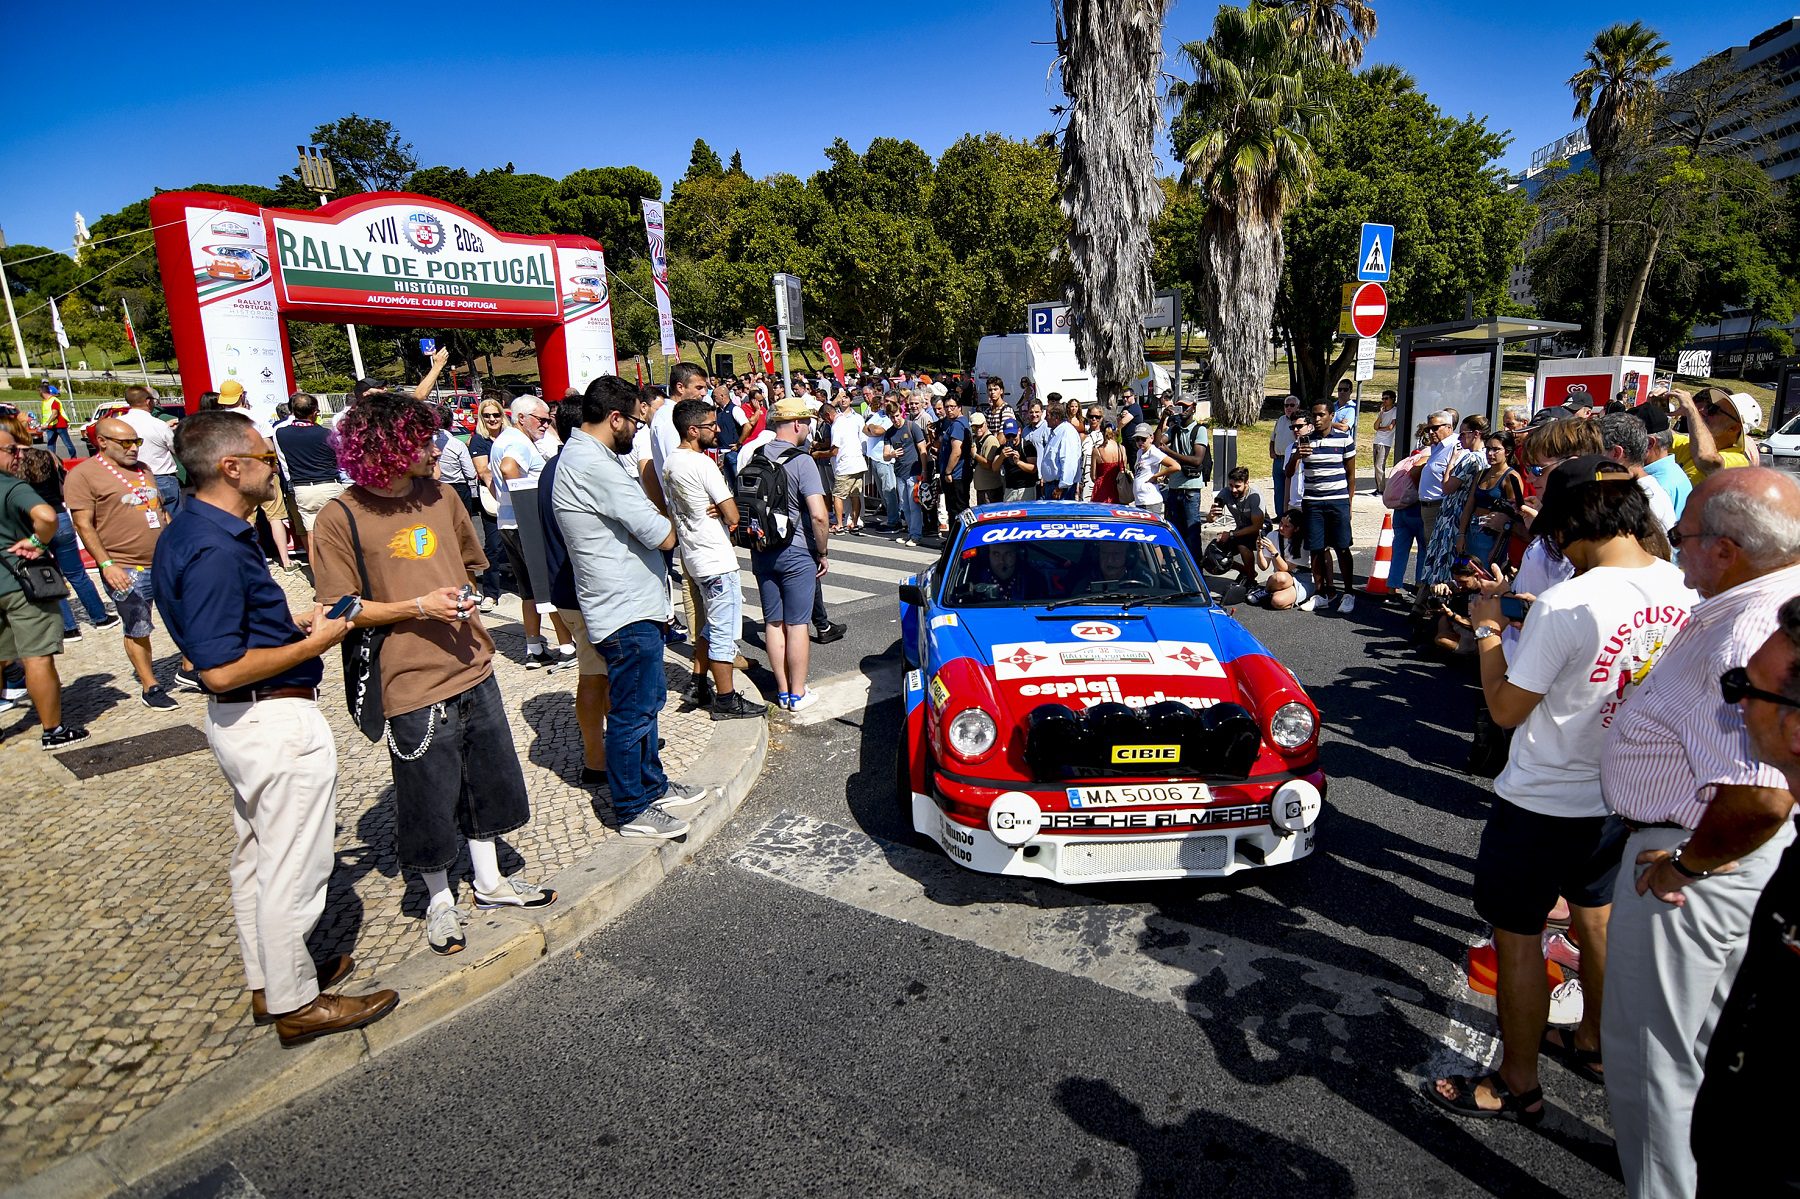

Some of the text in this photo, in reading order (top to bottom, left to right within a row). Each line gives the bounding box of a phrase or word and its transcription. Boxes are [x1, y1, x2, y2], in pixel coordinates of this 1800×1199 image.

[366, 216, 484, 253] XVII 2023
[276, 227, 372, 273] RALLY
[382, 254, 419, 277] DE
[426, 253, 555, 286] PORTUGAL
[394, 280, 469, 296] HISTÓRICO
[233, 303, 273, 311] PORTUGAL
[237, 298, 261, 306] RALLY
[367, 295, 498, 310] AUTOMÓVEL CLUB DE PORTUGAL
[1035, 312, 1047, 333] P
[1730, 352, 1774, 363] BURER KING
[983, 510, 1021, 519] acp
[1116, 510, 1152, 519] acp
[414, 527, 428, 556] F
[1077, 626, 1114, 635] ZR
[1009, 654, 1037, 664] CS
[1177, 653, 1204, 663] CS
[1588, 623, 1632, 683] DEUS
[1019, 676, 1120, 698] esplai
[1116, 748, 1176, 759] CIBIE
[1086, 786, 1205, 805] MA 5006 Z
[1041, 813, 1147, 828] ORSCHE
